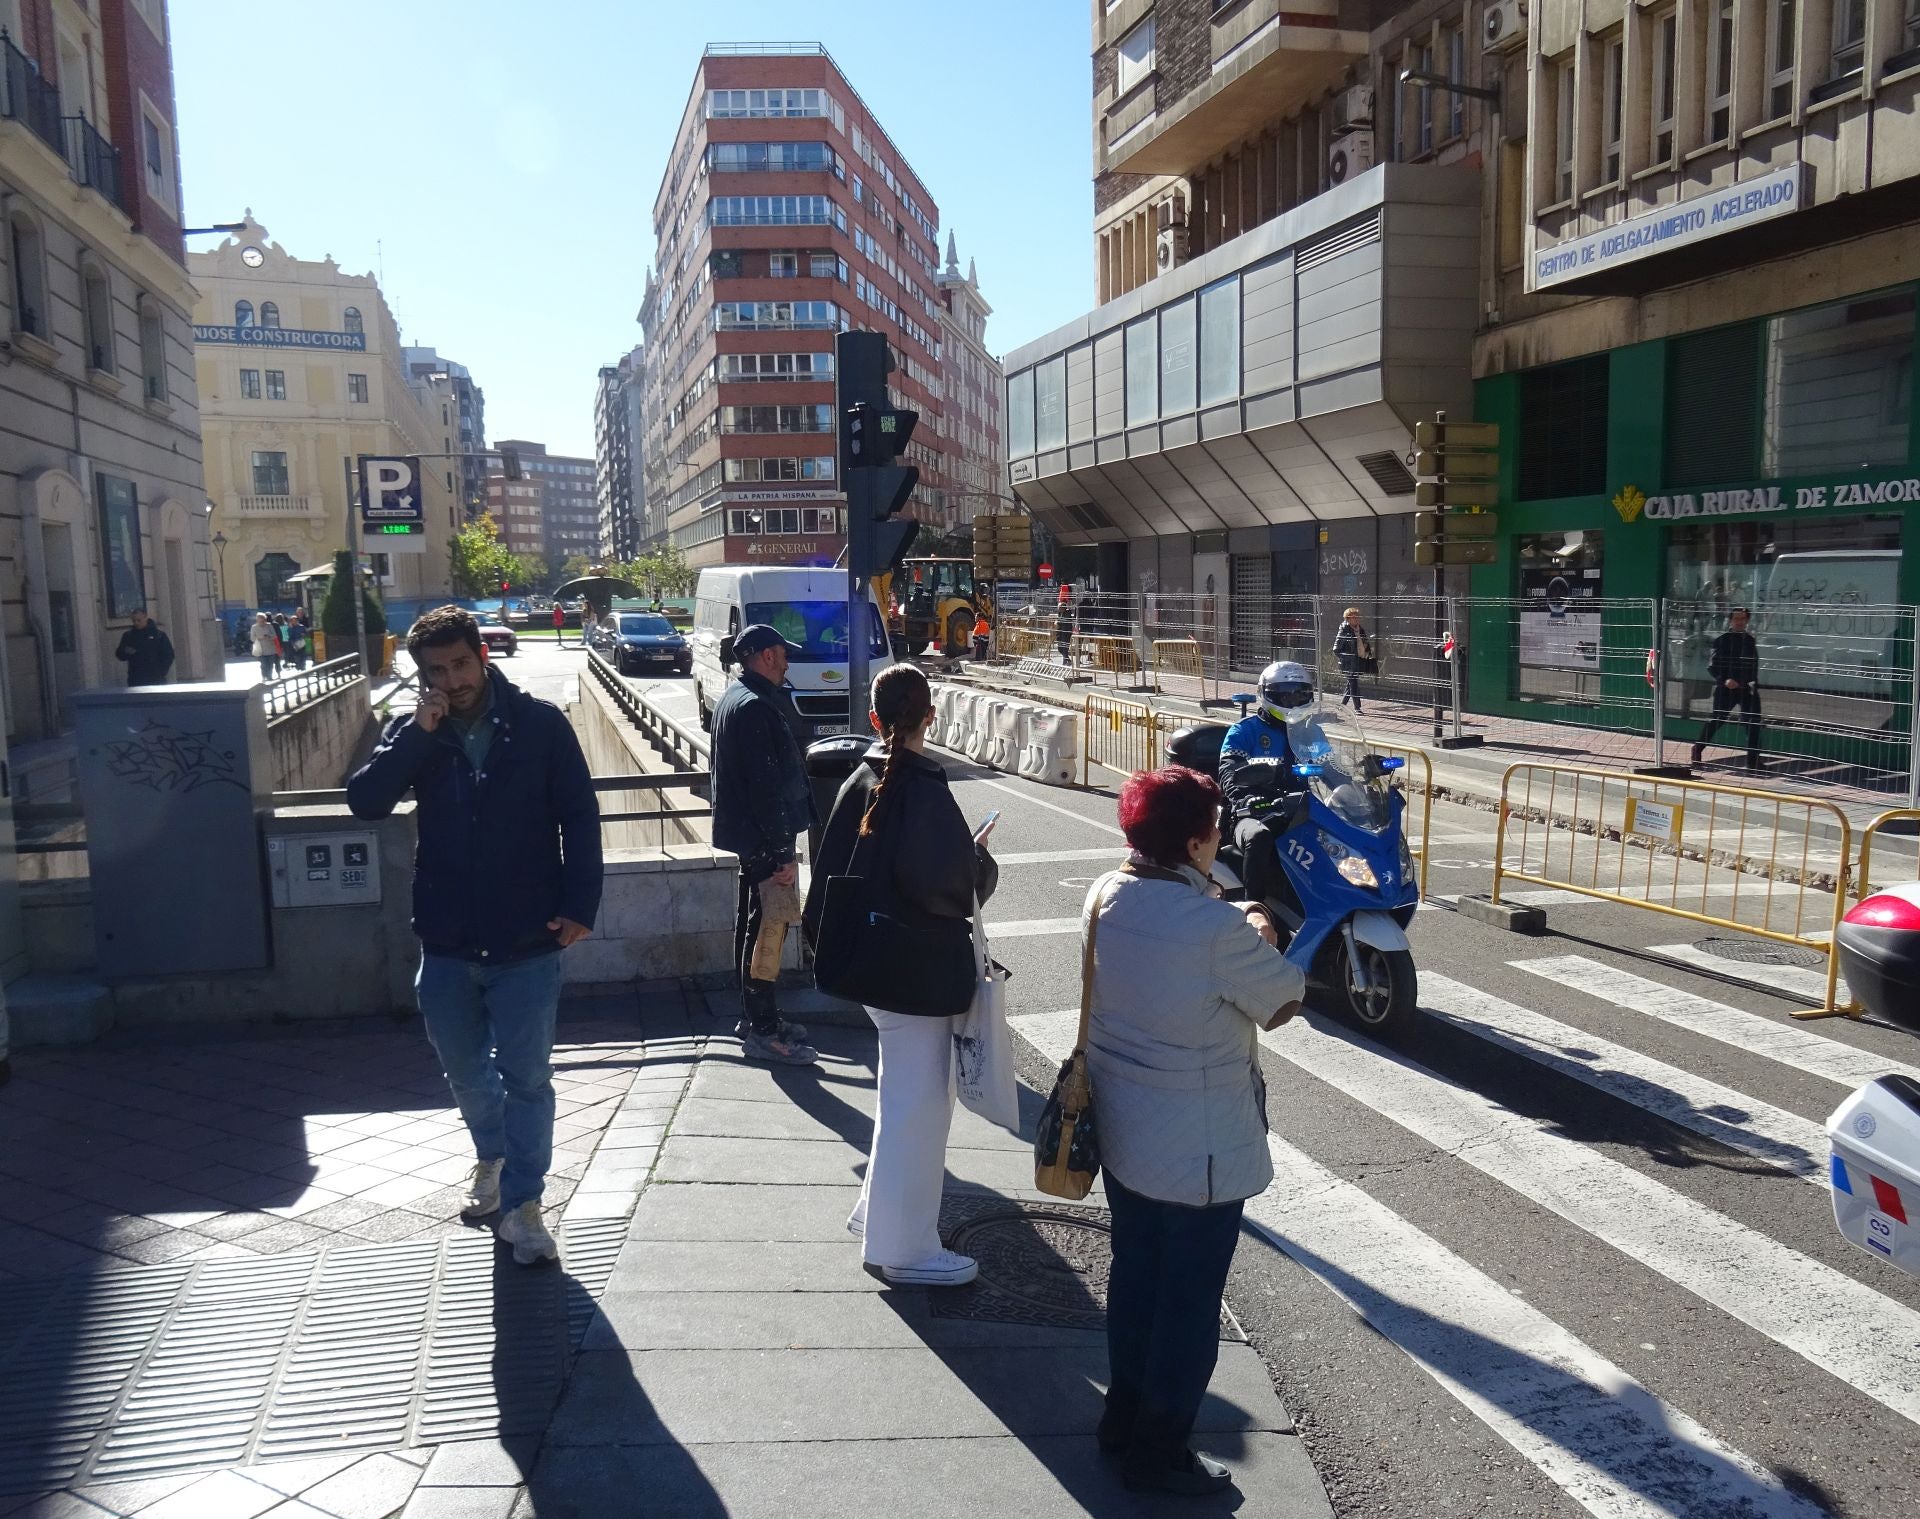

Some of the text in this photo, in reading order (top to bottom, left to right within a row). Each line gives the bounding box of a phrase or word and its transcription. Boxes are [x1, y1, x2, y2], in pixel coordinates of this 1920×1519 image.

[1537, 179, 1794, 279] CENTRO DE ADELGAZAMIENTO ACELERADO
[241, 328, 362, 347] CONSTRUCTORA
[366, 460, 412, 508] P
[1644, 478, 1920, 520] CAJA RURAL DE ZAMOR
[383, 525, 411, 534] LIBRE
[764, 543, 817, 554] GENERALI
[1288, 839, 1315, 872] 112
